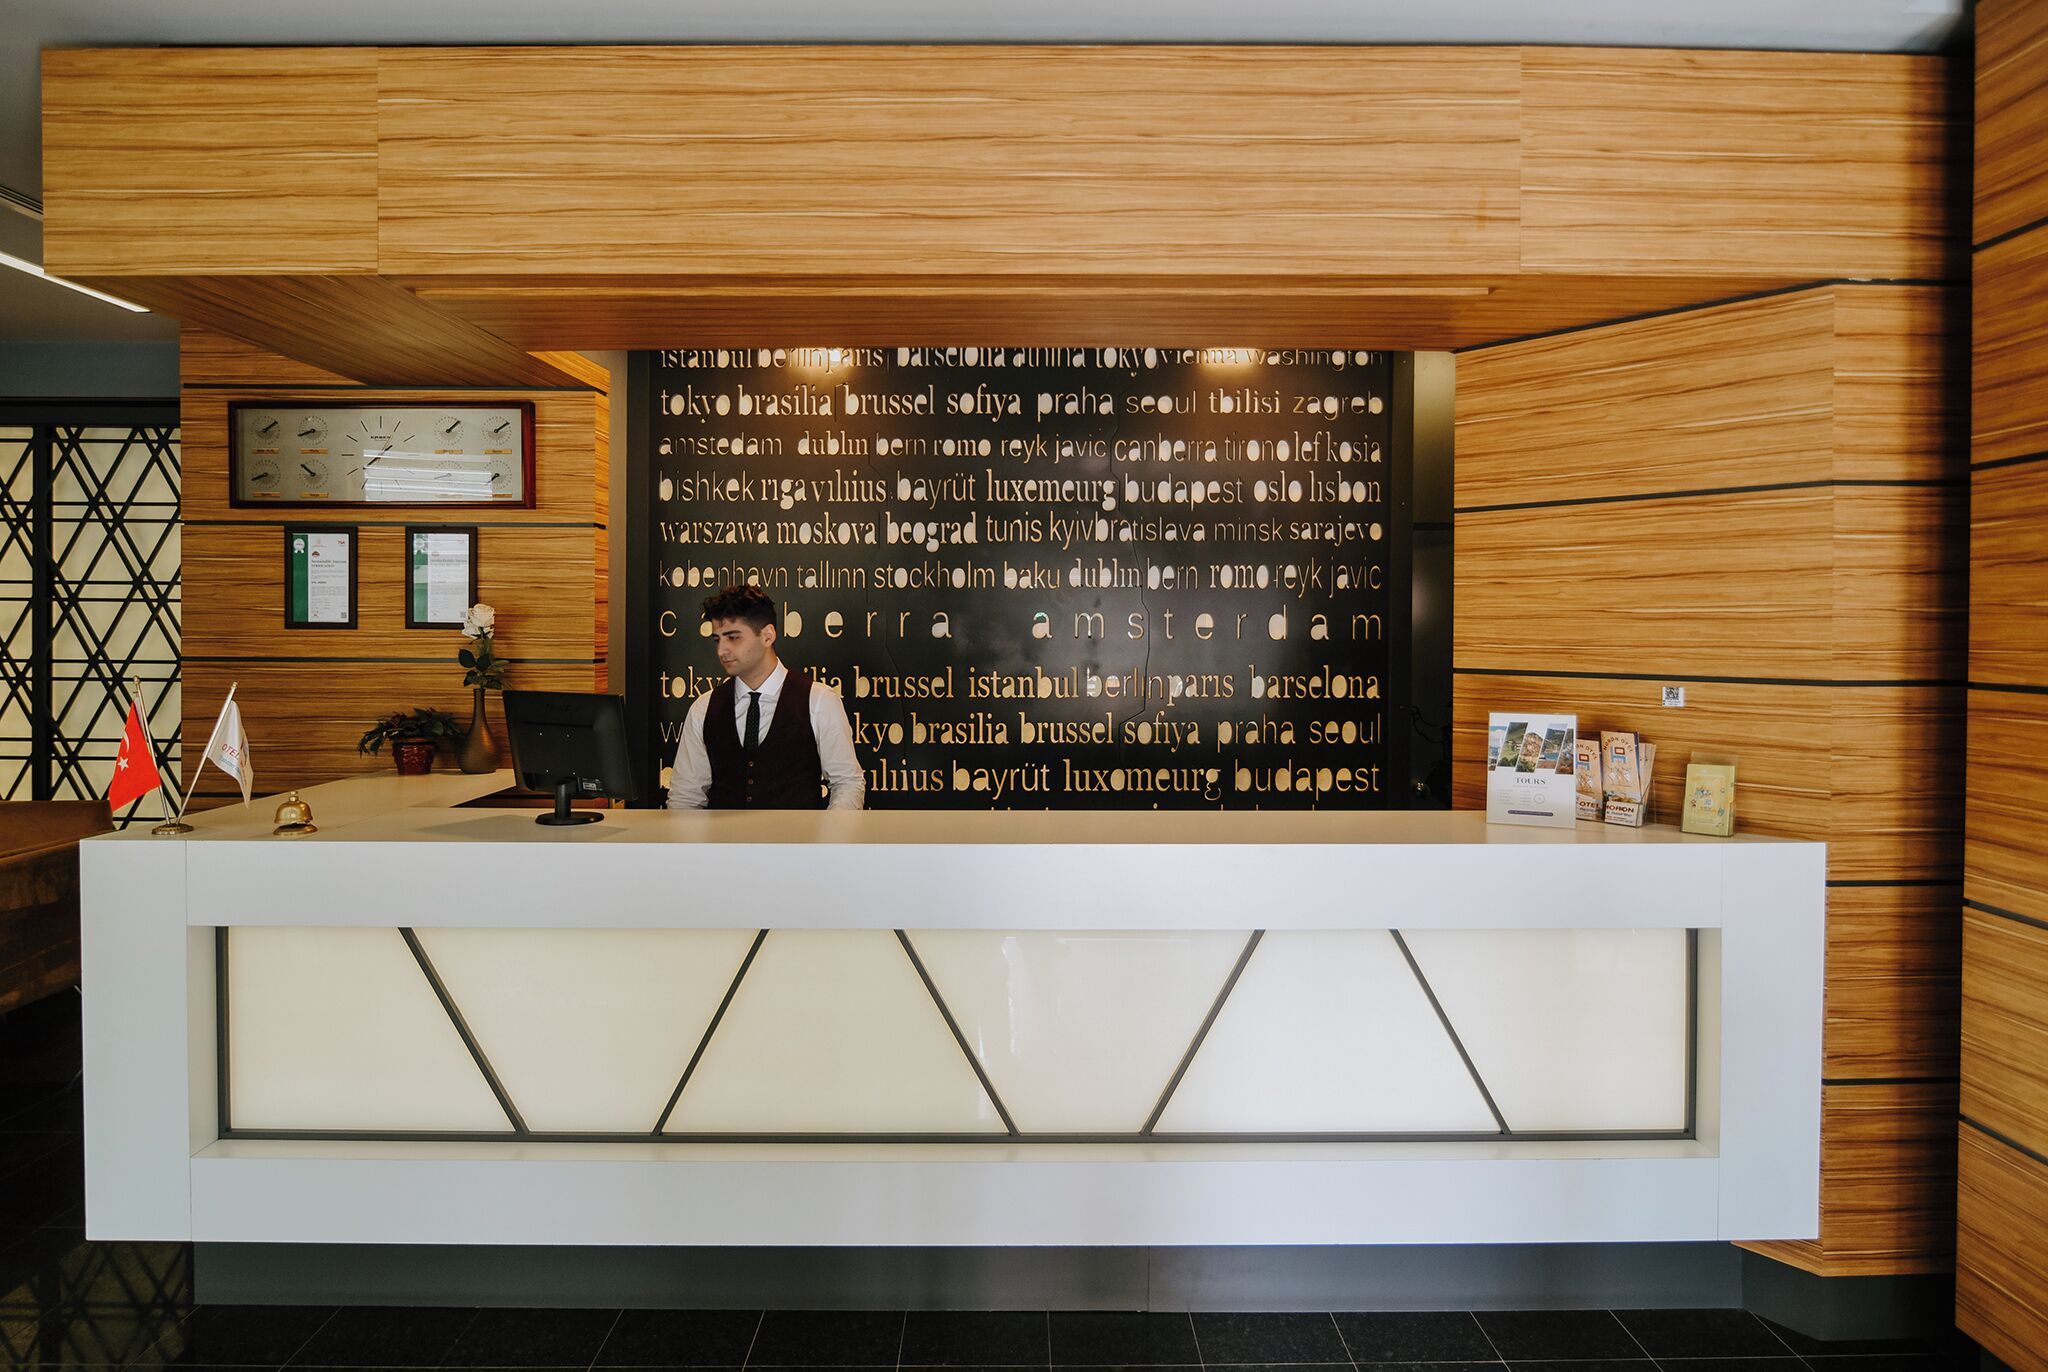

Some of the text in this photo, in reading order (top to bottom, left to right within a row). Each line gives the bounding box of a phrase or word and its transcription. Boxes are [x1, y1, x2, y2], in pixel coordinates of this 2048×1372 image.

[660, 384, 730, 424] tokyo
[738, 384, 832, 415] brasilia
[844, 383, 936, 415] brussel
[1037, 386, 1114, 422] praha
[1126, 389, 1197, 414] seoul
[1209, 388, 1280, 414] tbilisi
[1292, 391, 1383, 421] zagreb
[876, 432, 926, 456] bern
[934, 439, 992, 457] romo
[1114, 432, 1217, 463] canberra
[659, 470, 755, 502] bishkek
[897, 470, 976, 510] bayrüt
[986, 469, 1116, 511] luxemeurg
[1125, 473, 1243, 512] budapest
[1253, 471, 1302, 503] oslo
[660, 520, 769, 545] warszawa
[776, 511, 877, 545] moskova
[885, 511, 978, 552] beograd
[986, 514, 1043, 543] tunis
[1214, 517, 1283, 542] minsk
[1289, 515, 1383, 547] sarajevo
[874, 560, 996, 589] stockholm
[1004, 559, 1061, 590] baku
[1147, 557, 1198, 591] bern
[1209, 559, 1269, 590] romo
[659, 601, 1382, 642] caberra amsterdam
[853, 665, 954, 699] brussel
[968, 665, 1079, 699] istanbul
[1248, 665, 1382, 699] barselona
[221, 743, 240, 760] OTEL
[910, 711, 1009, 746] brasilia
[1018, 711, 1114, 746] brussel
[1217, 711, 1297, 754] praha
[1308, 712, 1382, 745] seoul
[952, 759, 1051, 800] bayrüt
[1234, 758, 1382, 801] budapest
[1516, 777, 1546, 785] TOURS
